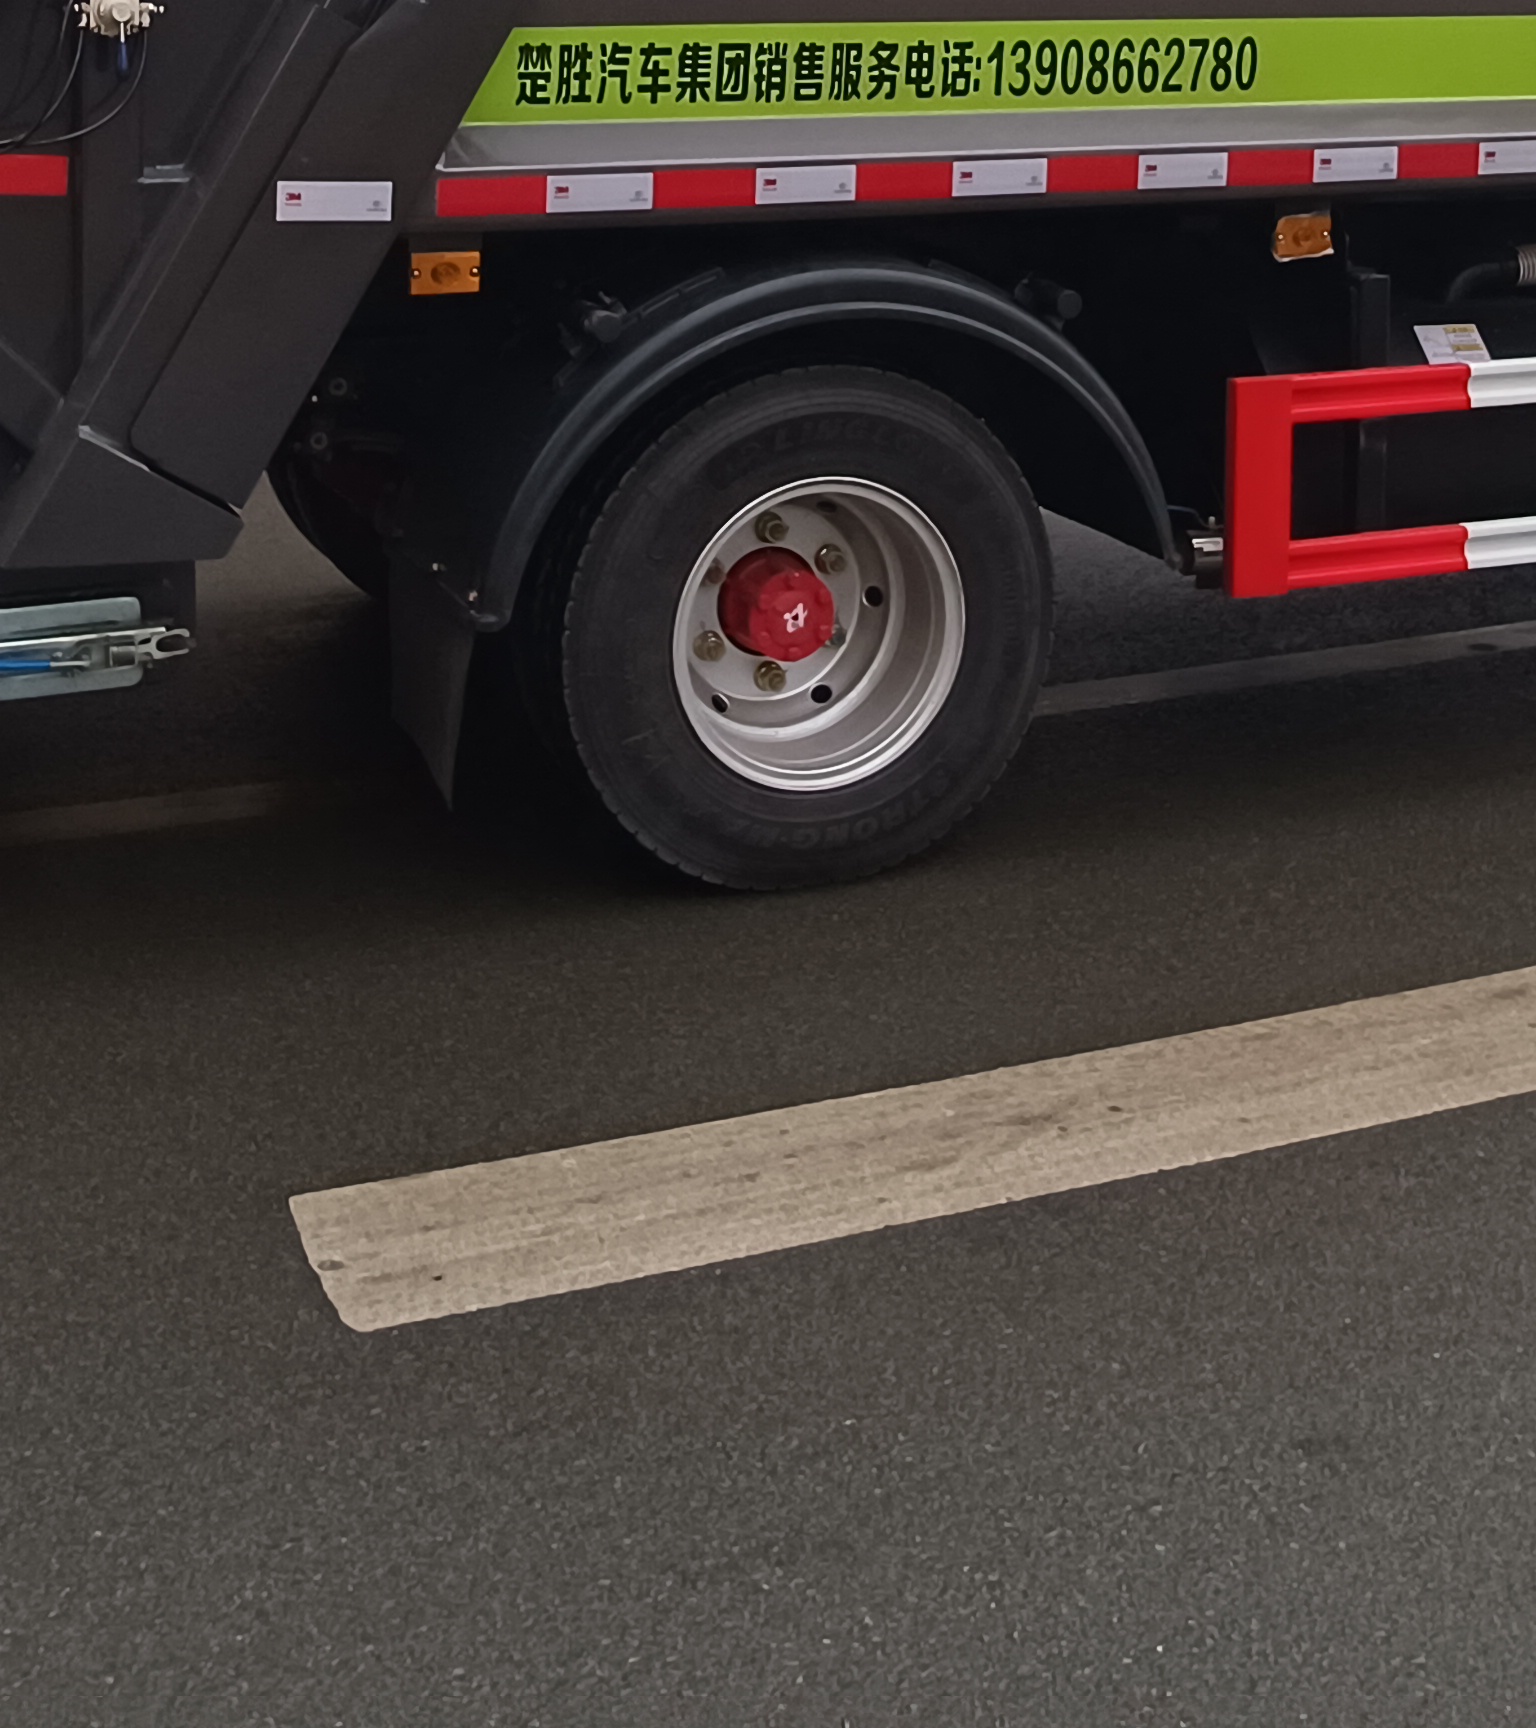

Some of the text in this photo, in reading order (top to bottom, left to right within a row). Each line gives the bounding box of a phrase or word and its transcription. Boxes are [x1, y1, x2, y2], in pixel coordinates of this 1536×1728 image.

[515, 36, 1258, 106] 楚胜汽车集团销售服务电话:13908662780
